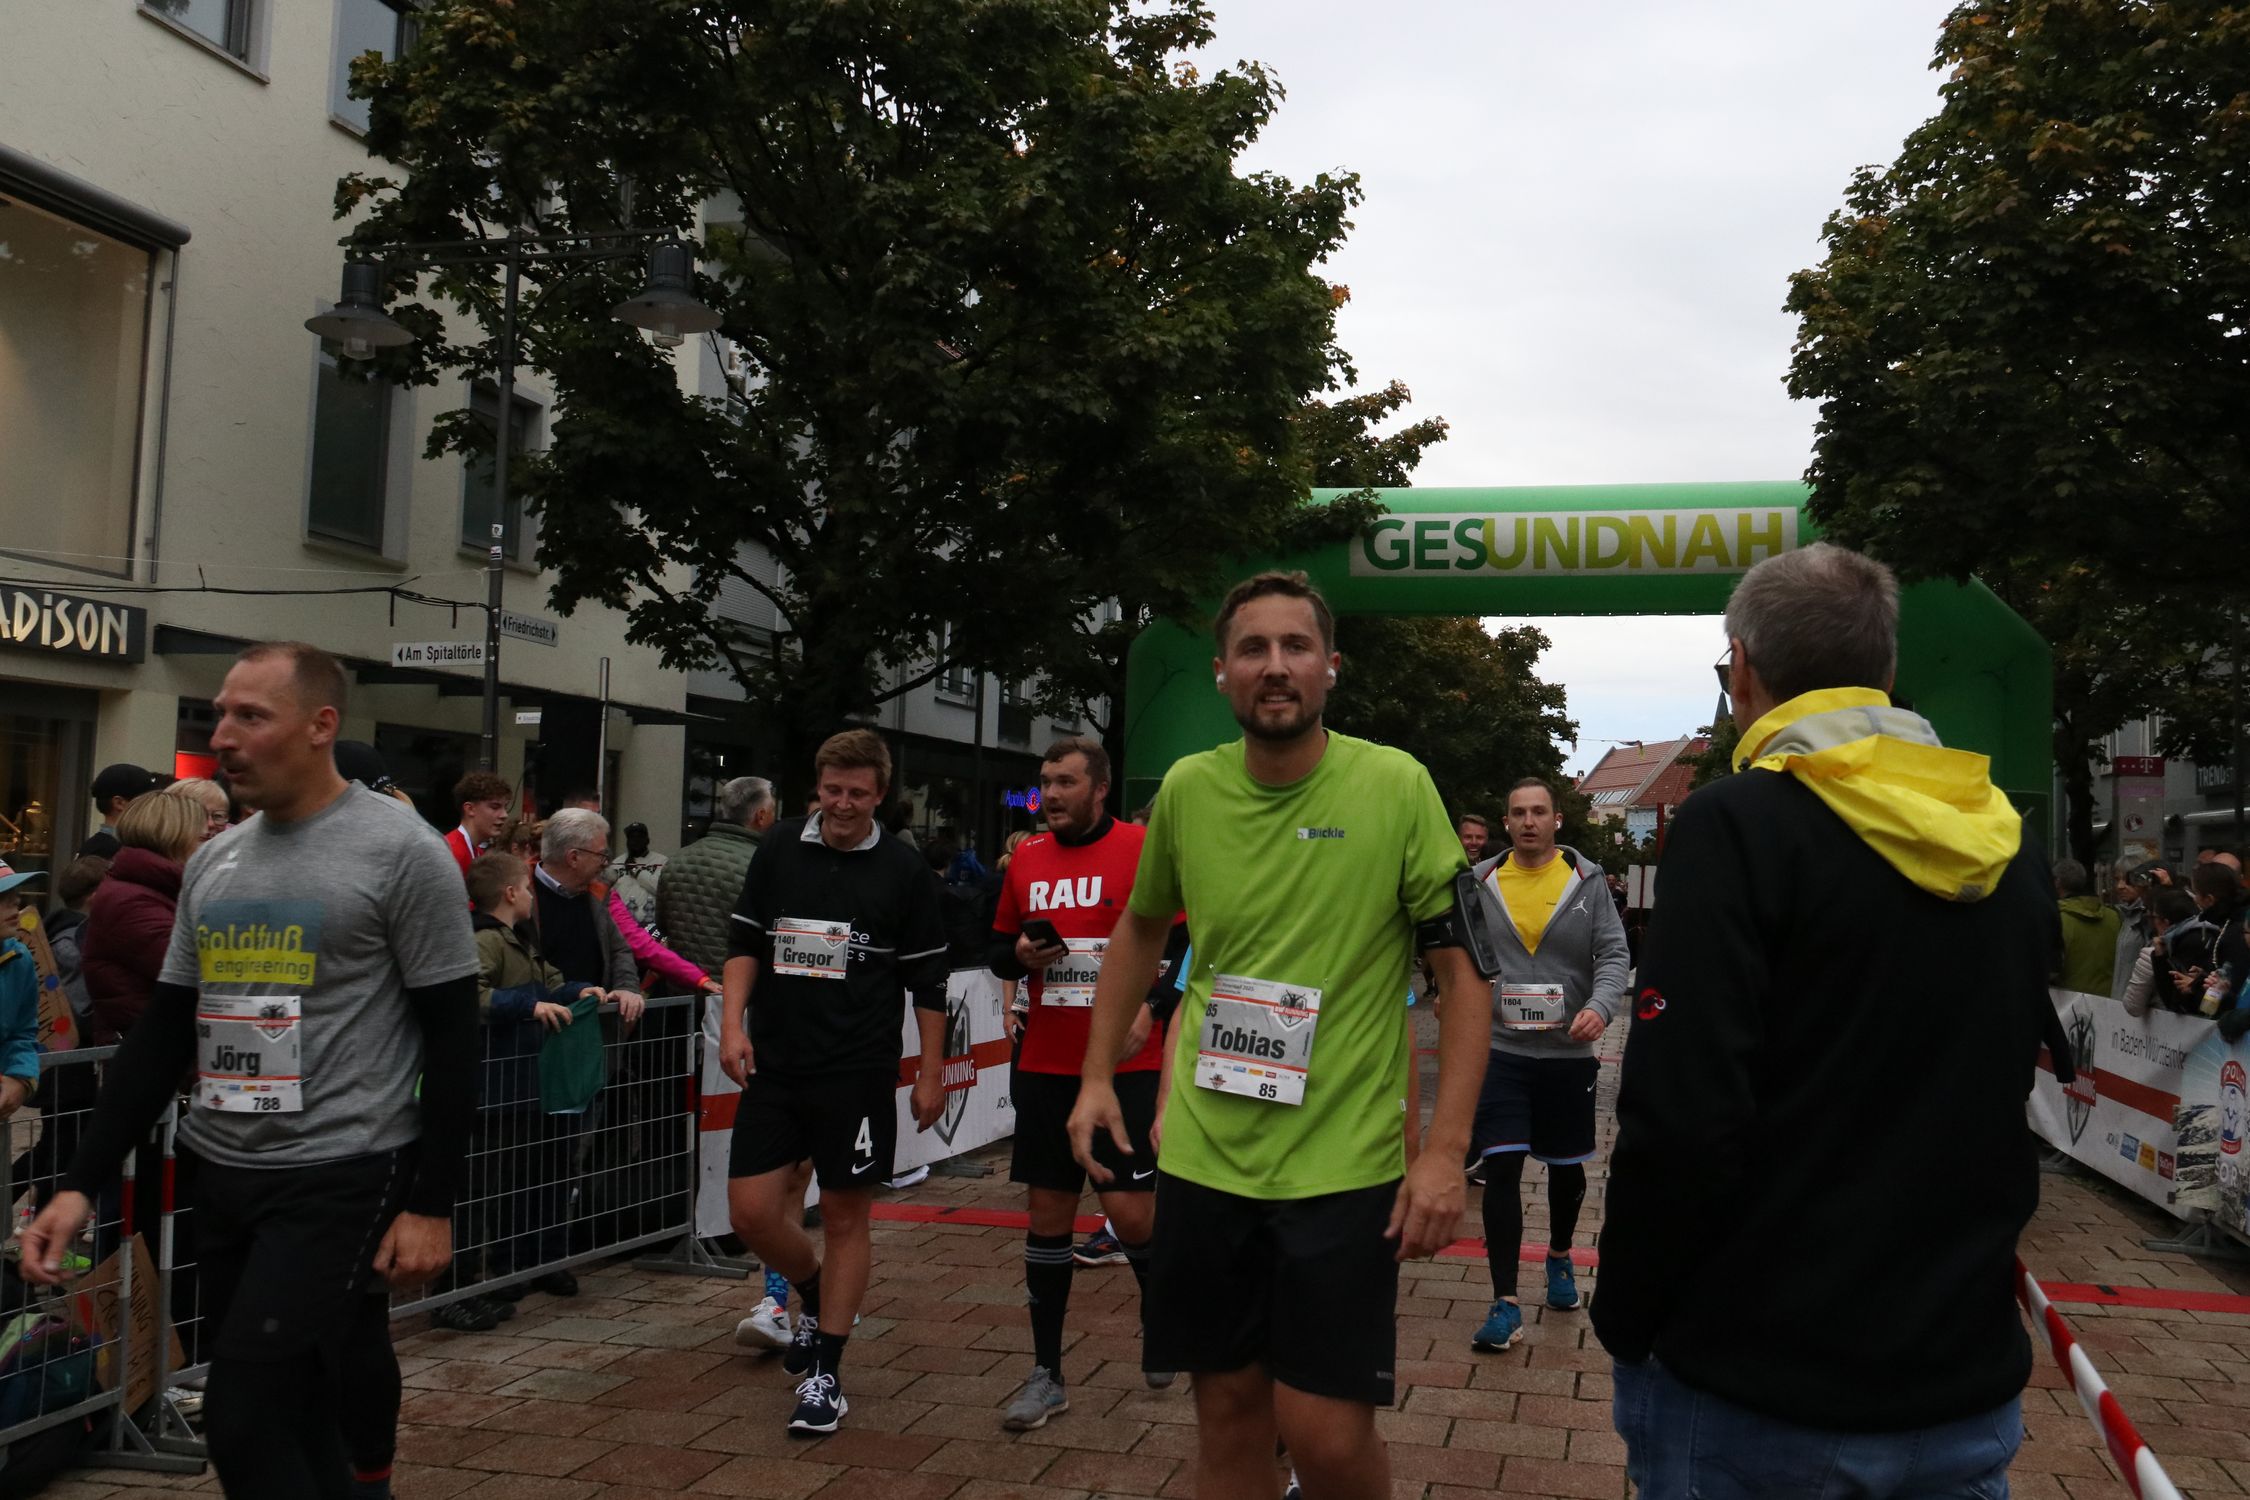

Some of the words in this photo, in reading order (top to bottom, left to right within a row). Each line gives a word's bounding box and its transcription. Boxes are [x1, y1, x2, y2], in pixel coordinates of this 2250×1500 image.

[1362, 513, 1783, 570] GESUNDNAH
[507, 616, 550, 640] Friedrichstr.
[405, 647, 422, 661] Am
[426, 645, 482, 663] Spitaltörle
[778, 935, 796, 945] 1401
[783, 947, 834, 968] Gregor
[1205, 1003, 1218, 1018] 85
[1519, 1008, 1544, 1021] Tim
[1211, 1023, 1287, 1060] Tobias
[211, 1045, 262, 1078] Jörg
[1258, 1082, 1278, 1099] 85
[253, 1097, 281, 1111] 788
[854, 1115, 873, 1158] 4
